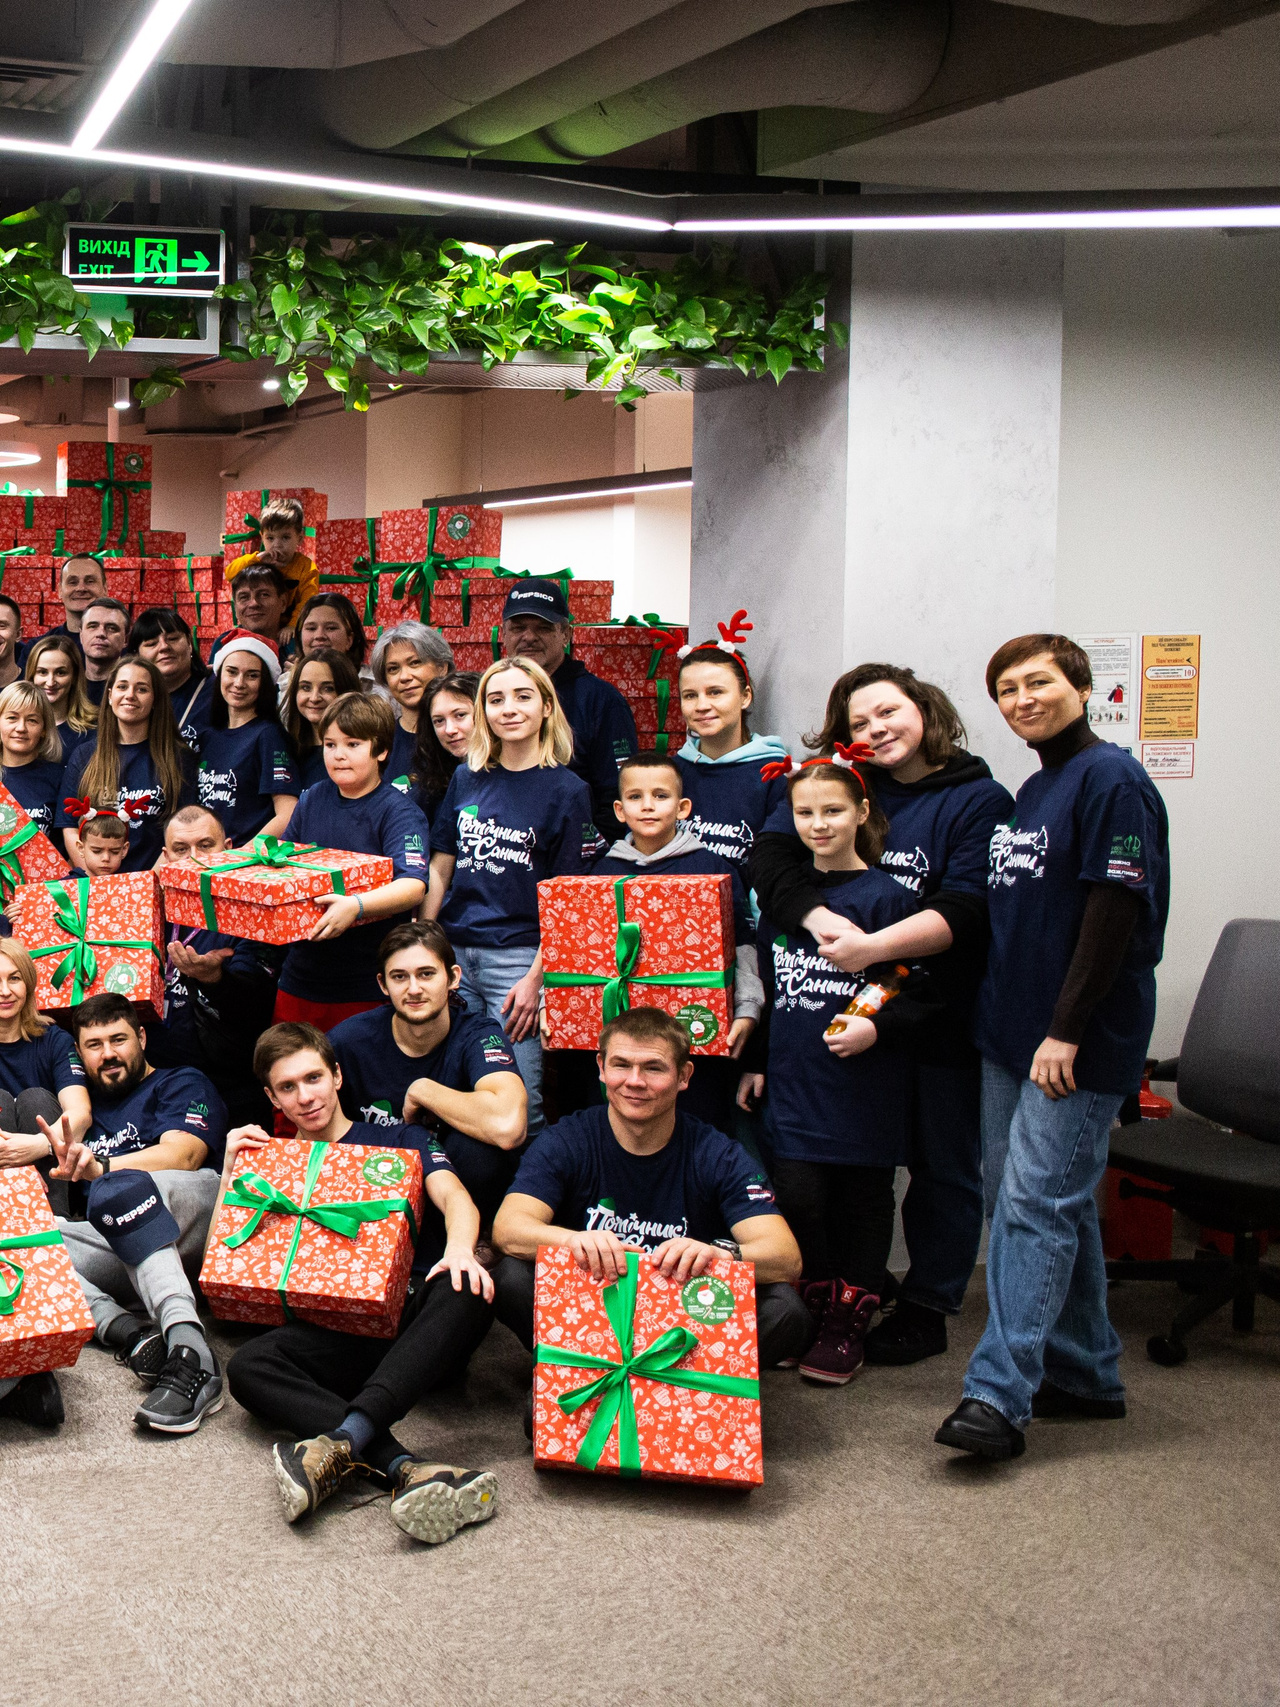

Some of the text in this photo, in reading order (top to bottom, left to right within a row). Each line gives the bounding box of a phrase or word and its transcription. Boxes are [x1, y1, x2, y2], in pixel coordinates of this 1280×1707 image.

[78, 239, 131, 259] ВИХІД
[517, 591, 555, 603] PEPSICO
[467, 838, 531, 865] Санти
[780, 968, 858, 997] Санти
[116, 1195, 158, 1226] PEPSICO
[587, 1204, 683, 1240] Помічник
